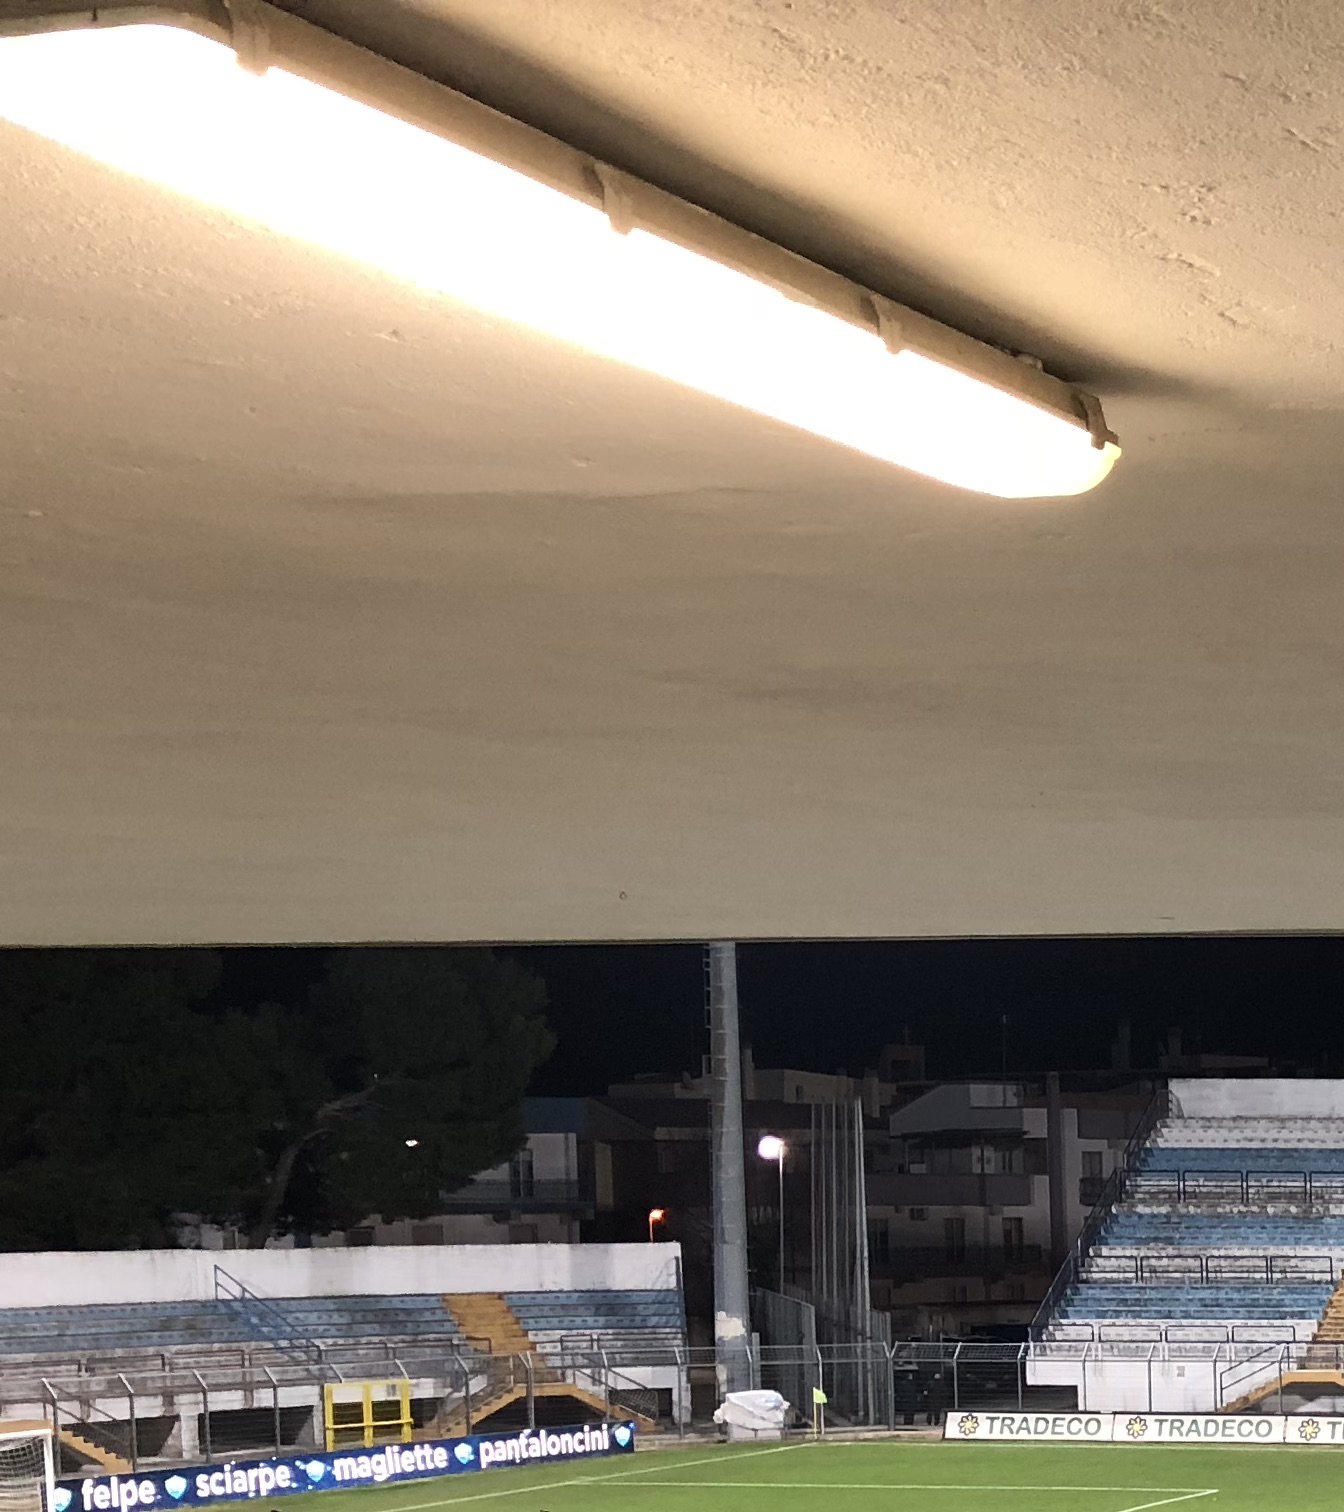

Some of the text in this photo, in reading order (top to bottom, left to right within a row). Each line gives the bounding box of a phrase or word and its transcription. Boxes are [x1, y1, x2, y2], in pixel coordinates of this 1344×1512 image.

[984, 1415, 1102, 1436] TRADECO
[1153, 1418, 1273, 1438] TRADECO
[195, 1464, 291, 1497] sciarpe
[332, 1444, 448, 1481] magliette
[479, 1424, 609, 1468] pantaloncini
